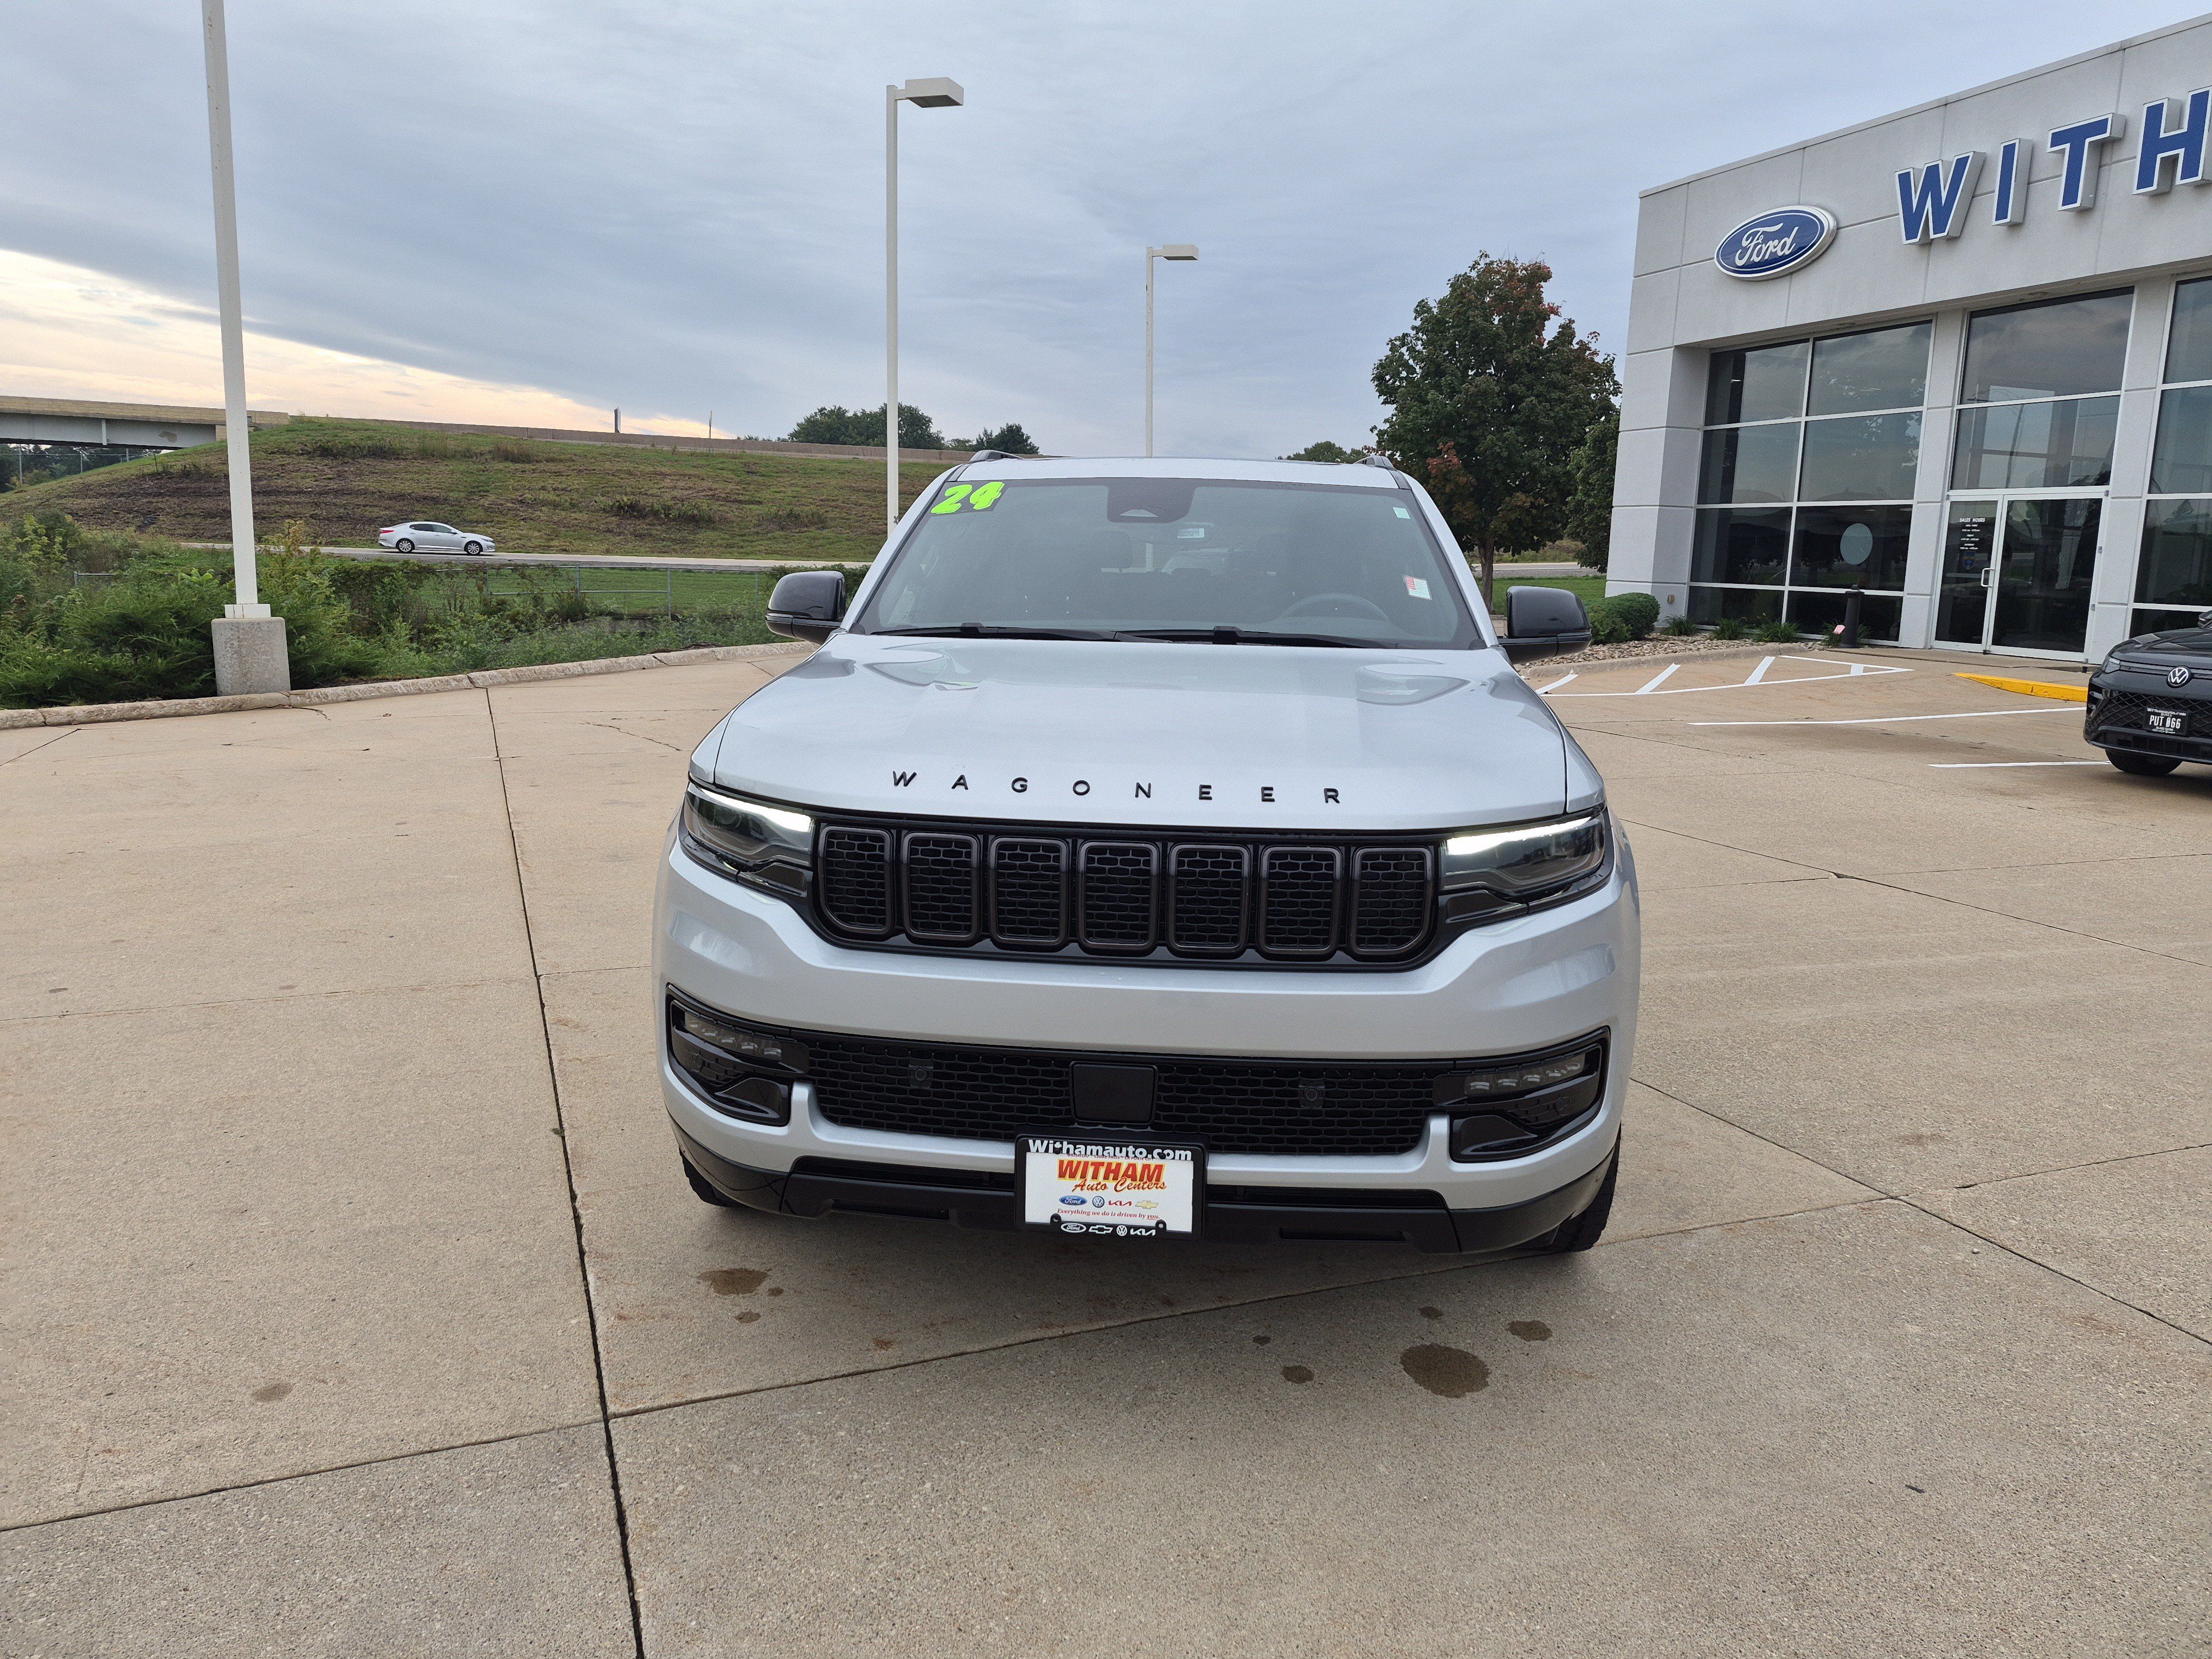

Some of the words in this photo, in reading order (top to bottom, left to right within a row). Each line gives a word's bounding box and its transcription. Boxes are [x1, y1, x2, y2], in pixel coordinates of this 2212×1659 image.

[1894, 85, 2212, 246] WITH
[1735, 222, 1799, 266] Ford
[930, 481, 1005, 514] 24
[2149, 715, 2165, 726] PUT
[2165, 717, 2181, 729] 066
[892, 771, 1341, 804] WAGONEER
[1028, 1139, 1192, 1161] Withamauto.com
[1058, 1159, 1165, 1182] WITHAM
[1072, 1178, 1108, 1192] Auto
[1114, 1177, 1167, 1192] Centers
[1057, 1208, 1091, 1216] Everything
